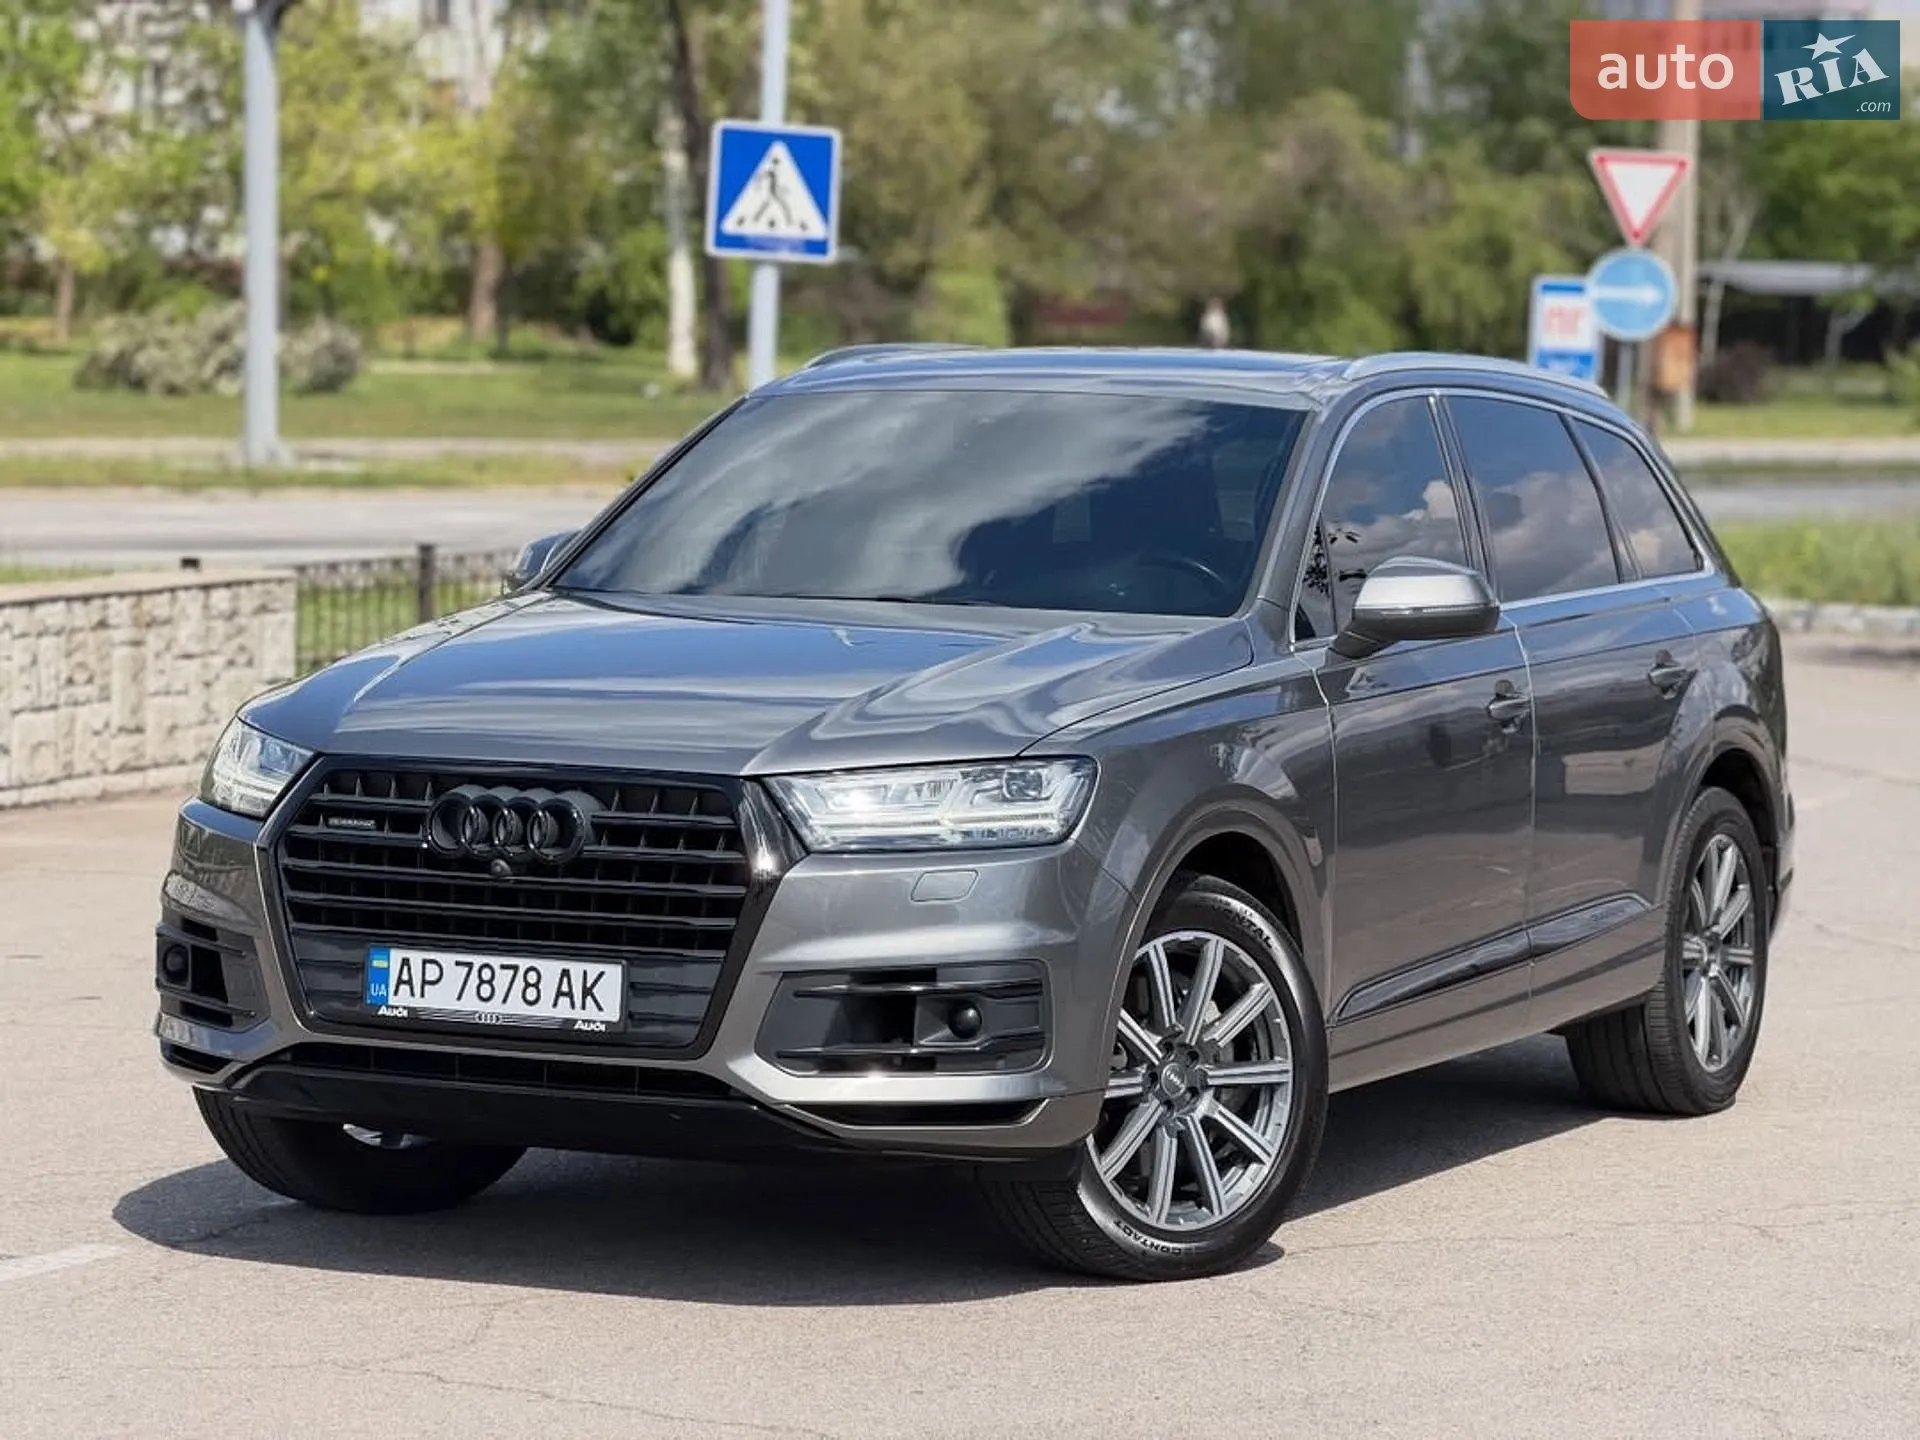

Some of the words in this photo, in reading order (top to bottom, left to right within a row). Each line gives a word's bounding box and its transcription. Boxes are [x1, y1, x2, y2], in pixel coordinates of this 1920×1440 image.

[371, 983, 387, 997] UA
[393, 957, 444, 998] AP
[454, 960, 542, 1007] 7878
[551, 968, 606, 1013] AK
